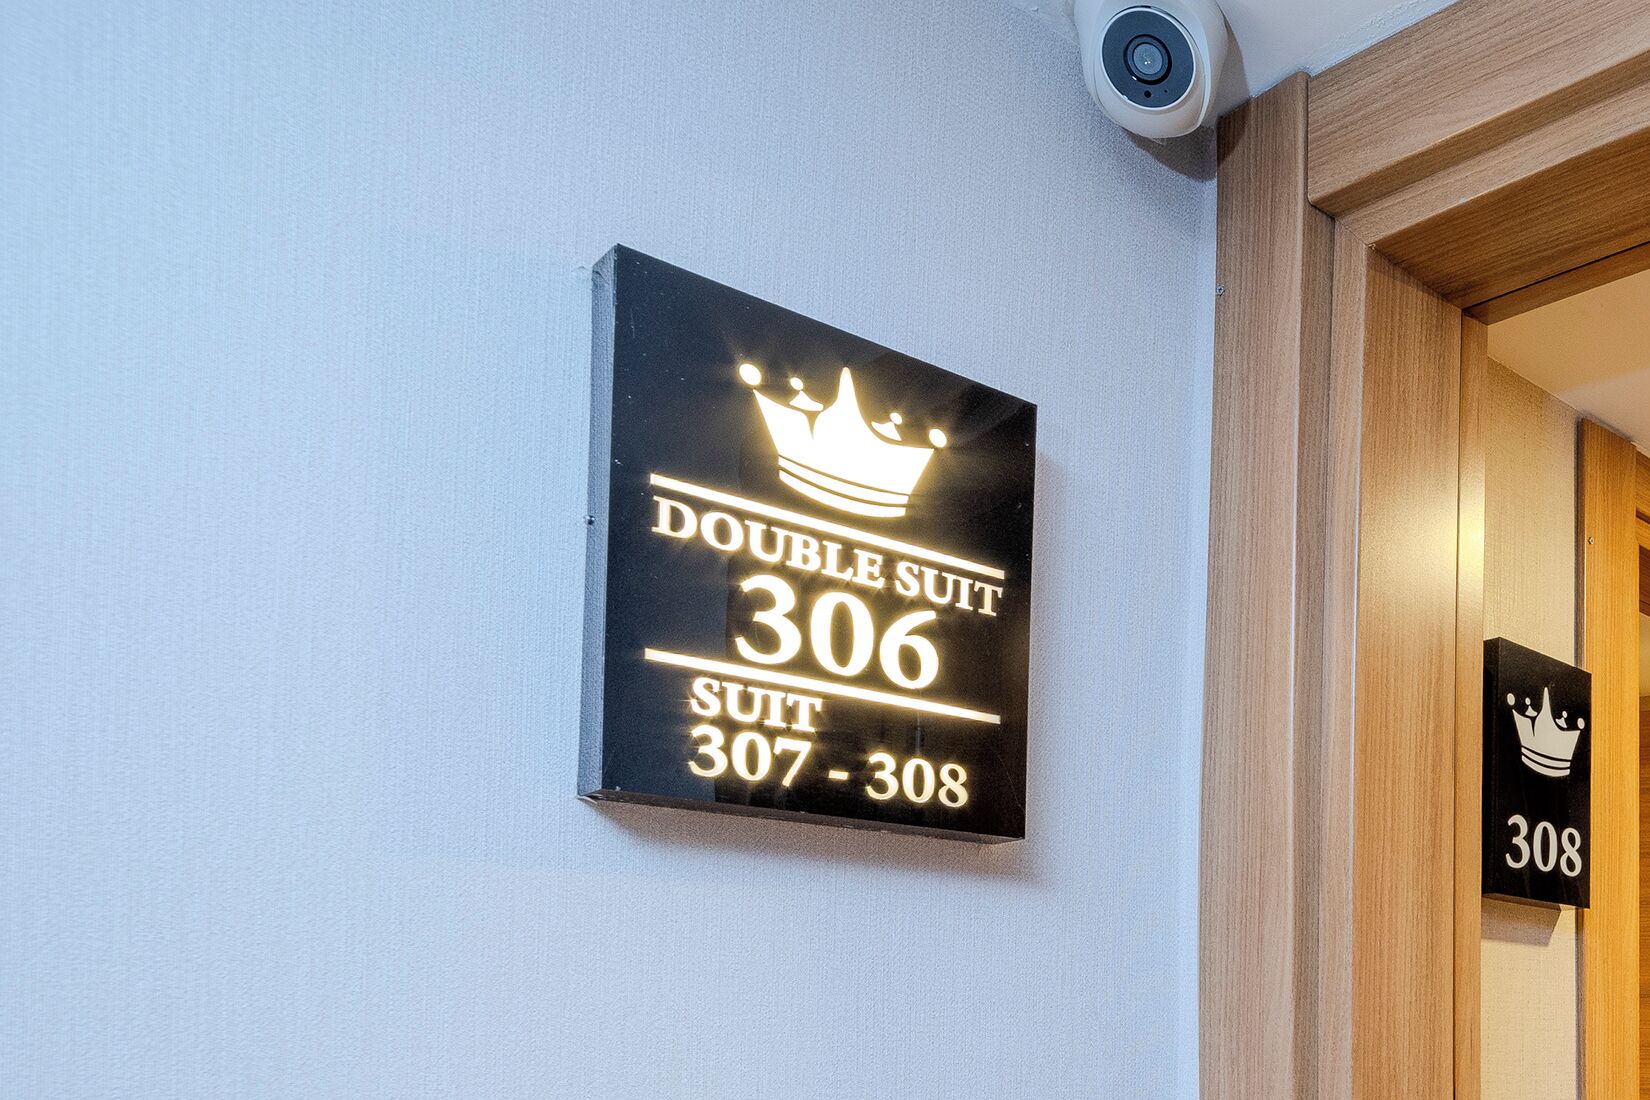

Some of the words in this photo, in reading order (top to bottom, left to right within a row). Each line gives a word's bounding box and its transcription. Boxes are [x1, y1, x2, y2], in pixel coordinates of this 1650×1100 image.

[651, 494, 884, 588] DOUBLE
[895, 561, 1004, 617] SUIT
[733, 574, 941, 691] 306
[689, 675, 823, 733] SUIT
[687, 724, 815, 788] 307
[828, 768, 849, 781] -
[865, 751, 969, 809] 308
[1505, 813, 1583, 878] 308
